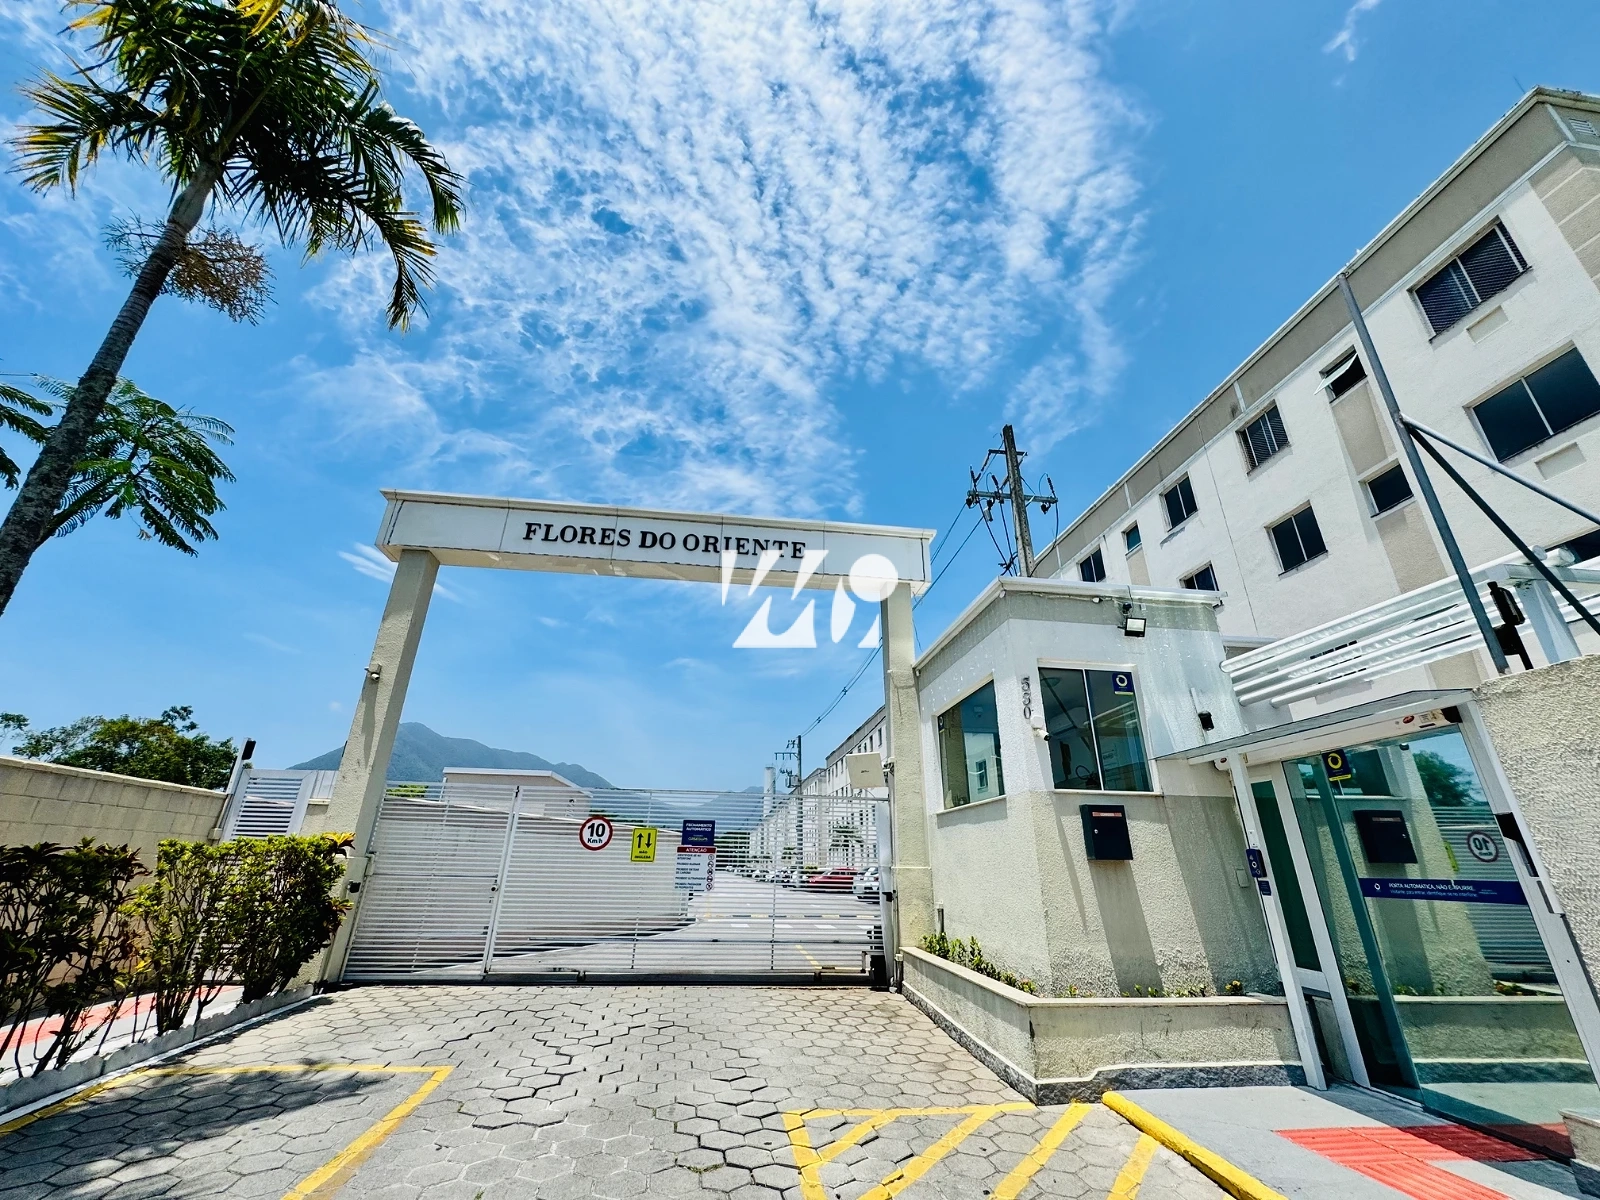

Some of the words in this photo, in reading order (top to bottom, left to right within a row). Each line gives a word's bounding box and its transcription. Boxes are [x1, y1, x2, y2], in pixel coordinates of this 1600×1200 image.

[522, 522, 631, 547] FLORES
[638, 530, 676, 550] DO
[682, 533, 806, 559] ORIENTE
[588, 822, 606, 837] 10
